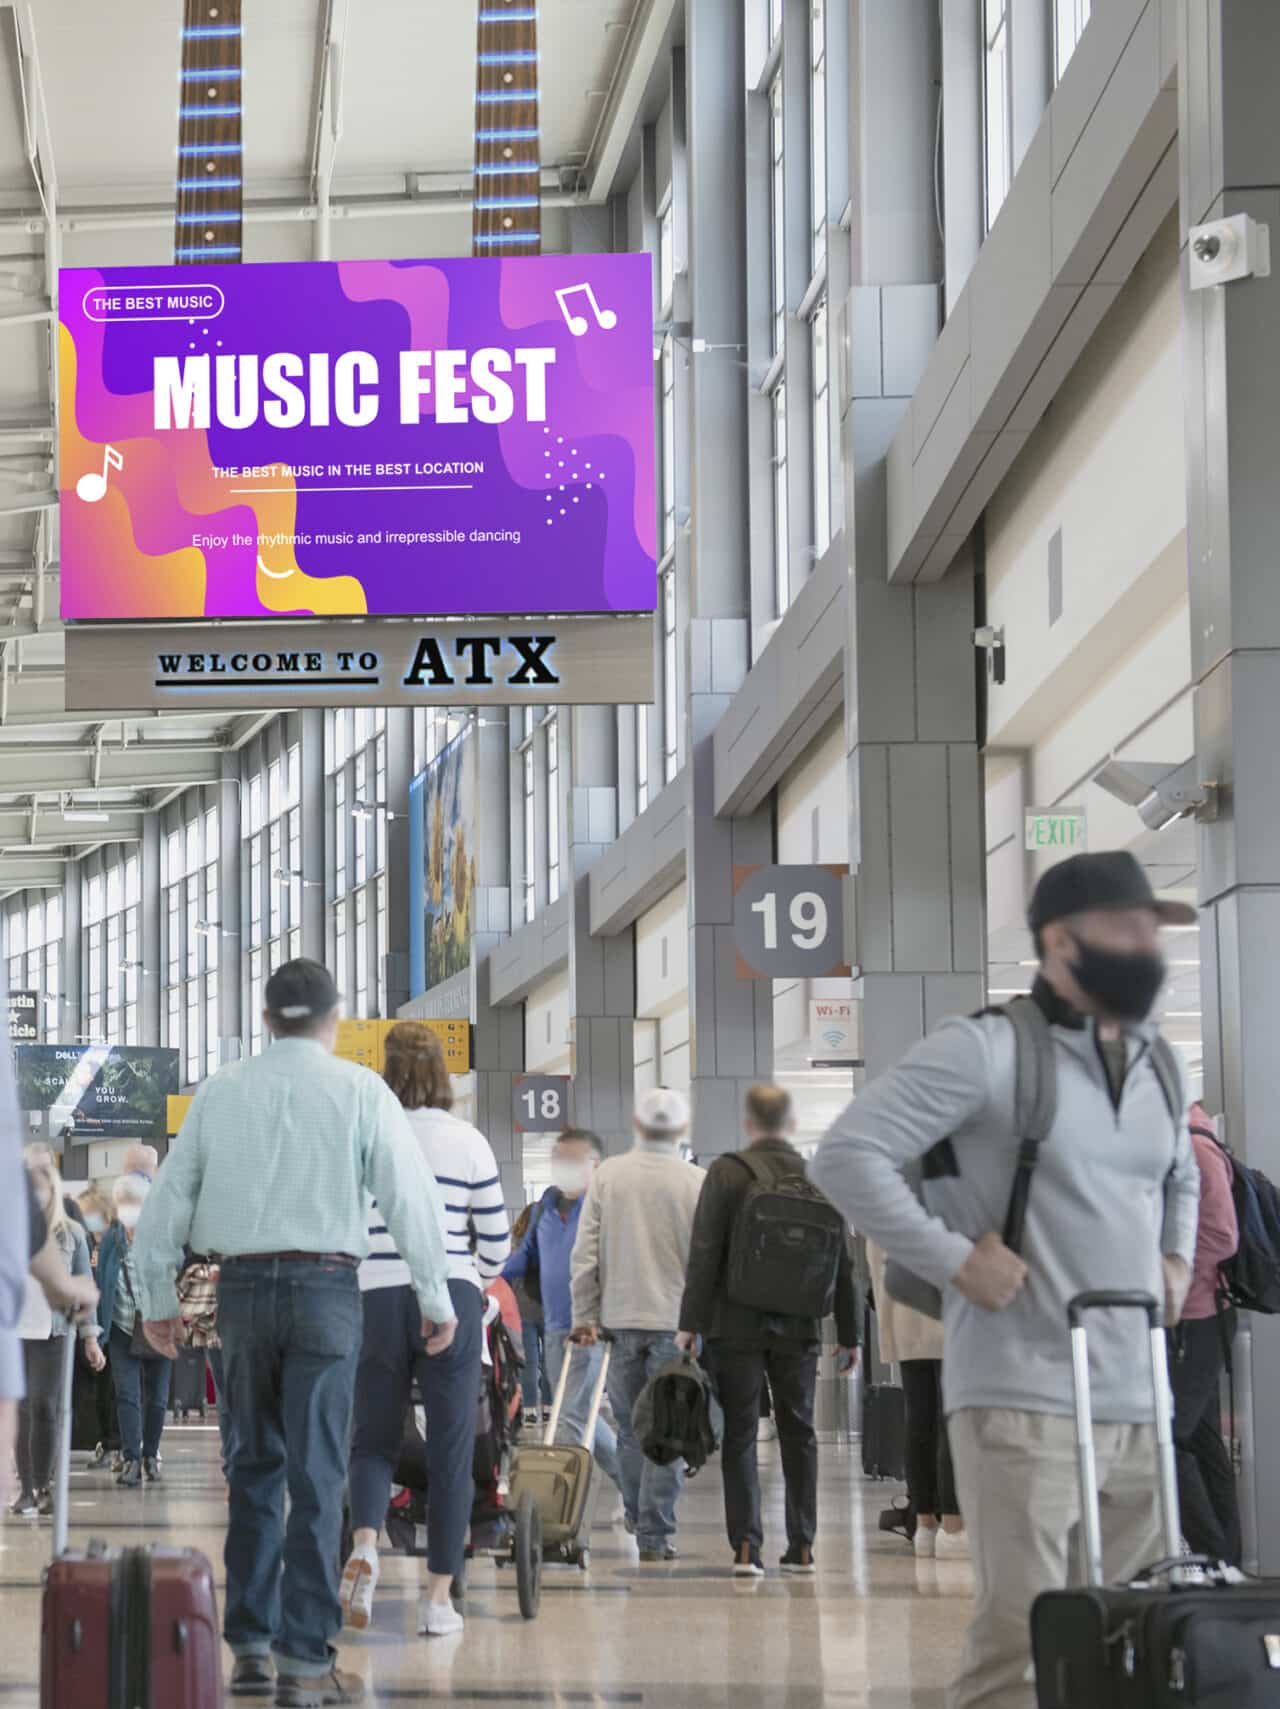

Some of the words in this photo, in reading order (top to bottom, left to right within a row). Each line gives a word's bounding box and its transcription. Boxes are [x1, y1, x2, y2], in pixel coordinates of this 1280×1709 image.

[93, 297, 121, 310] THE
[125, 296, 163, 310] BEST
[167, 295, 213, 309] MUSIC
[153, 350, 379, 430] MUSIC
[399, 347, 557, 425] FEST
[212, 466, 238, 479] THE
[242, 465, 278, 478] BEST
[282, 464, 324, 477] MUSIC
[328, 464, 341, 476] IN
[345, 464, 372, 476] THE
[375, 463, 410, 476] BEST
[415, 461, 485, 475] LOCATION
[192, 533, 229, 549] Enjoy
[232, 533, 253, 546] the
[256, 532, 312, 549] rhythmic
[315, 531, 354, 545] music
[357, 531, 382, 545] and
[385, 530, 466, 546] irrepressible
[469, 529, 521, 545] dancing
[158, 652, 322, 674] WELCOME
[337, 652, 378, 671] TO
[403, 636, 560, 686] ATX
[1035, 816, 1077, 845] EXIT
[751, 891, 828, 950] 19
[815, 1005, 851, 1017] Wi-Fi
[95, 1087, 115, 1095] YOU
[521, 1088, 561, 1119] 18
